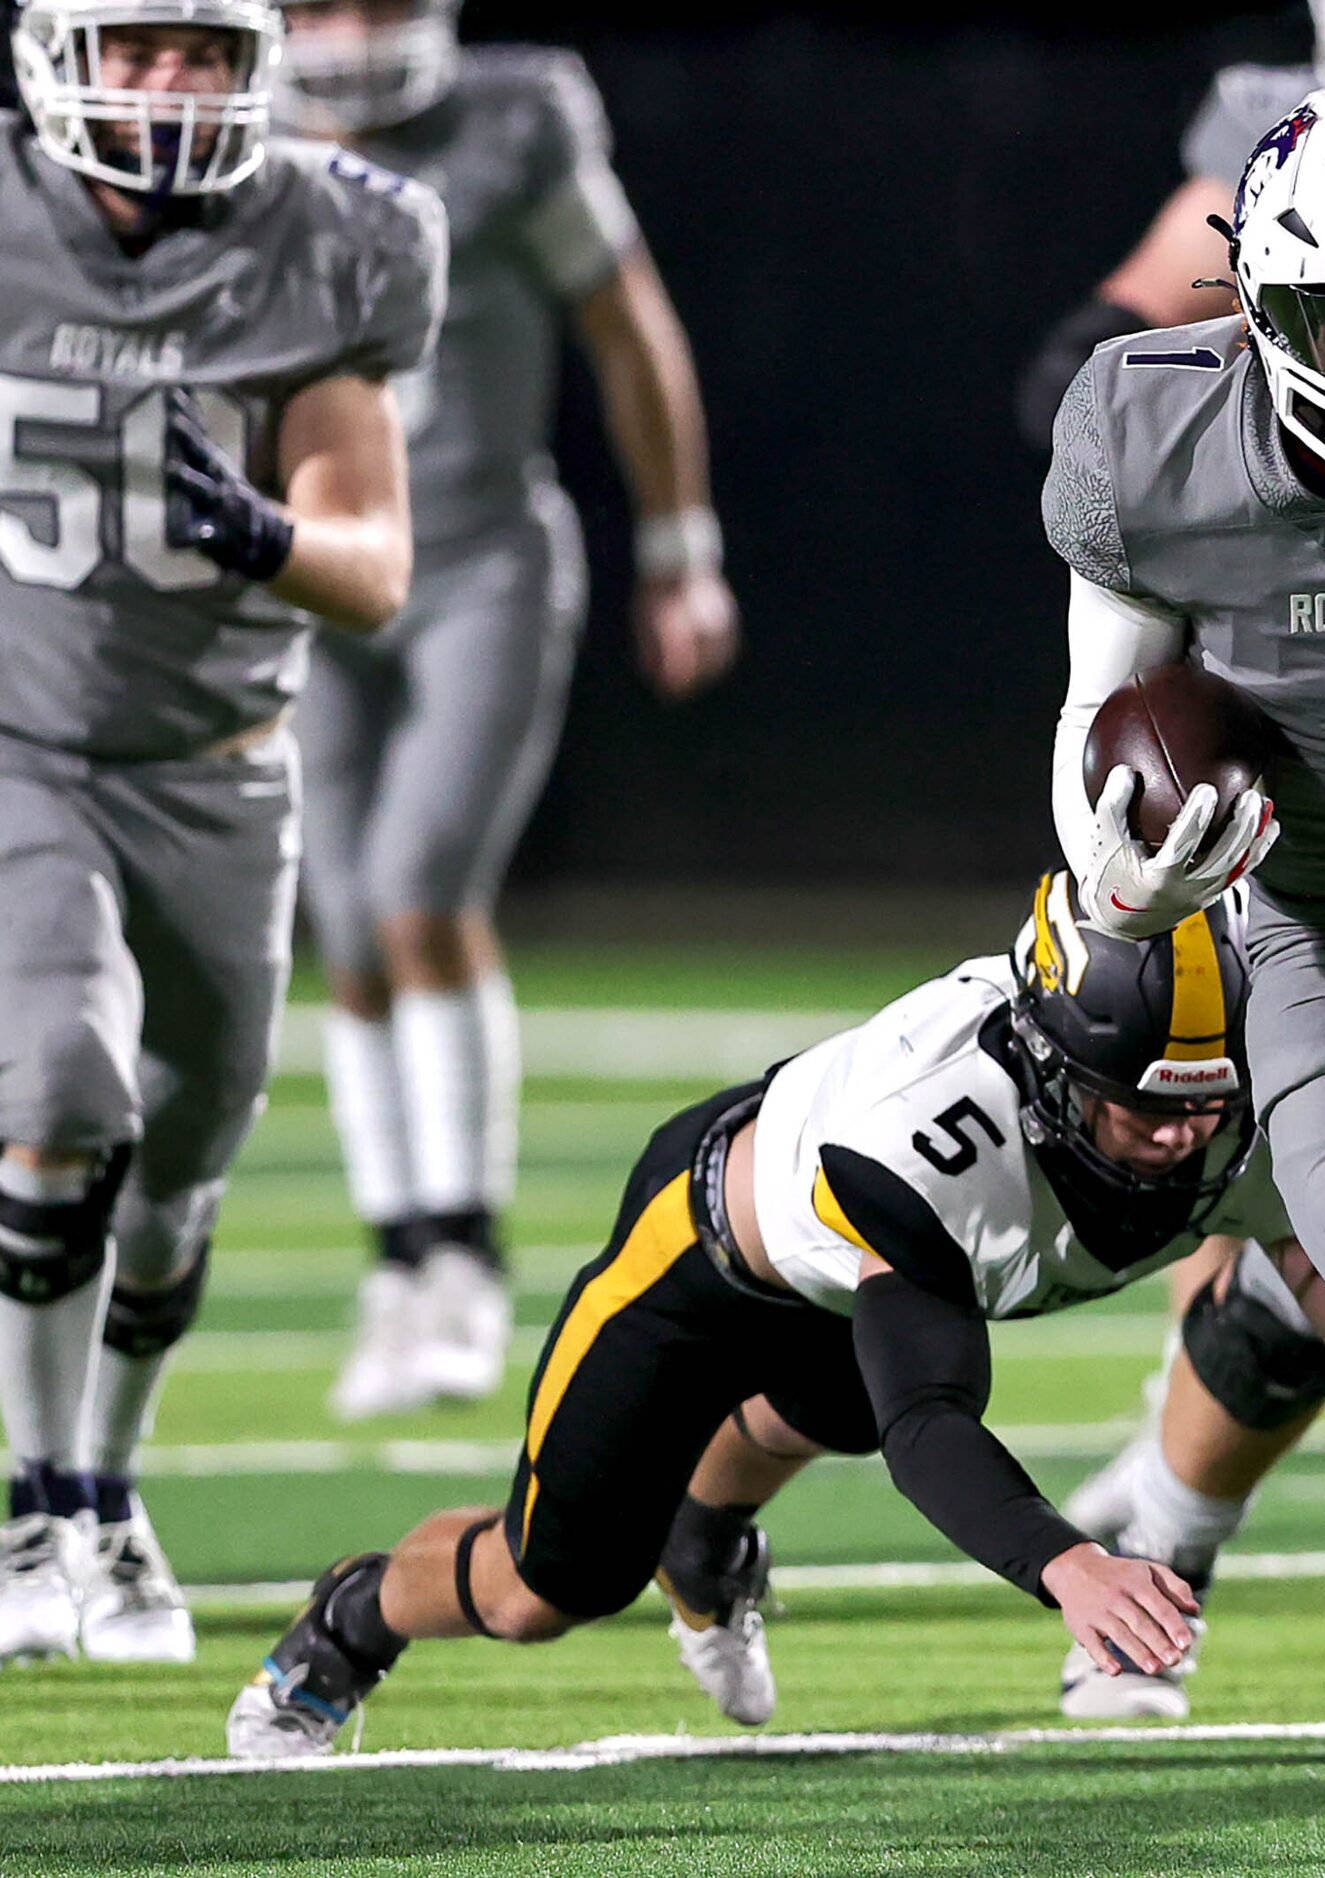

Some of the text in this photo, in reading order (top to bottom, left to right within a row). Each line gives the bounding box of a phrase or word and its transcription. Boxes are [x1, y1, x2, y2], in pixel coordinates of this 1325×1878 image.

[1121, 345, 1225, 372] 1
[1158, 1066, 1229, 1085] Riddell
[911, 1095, 1007, 1177] 5
